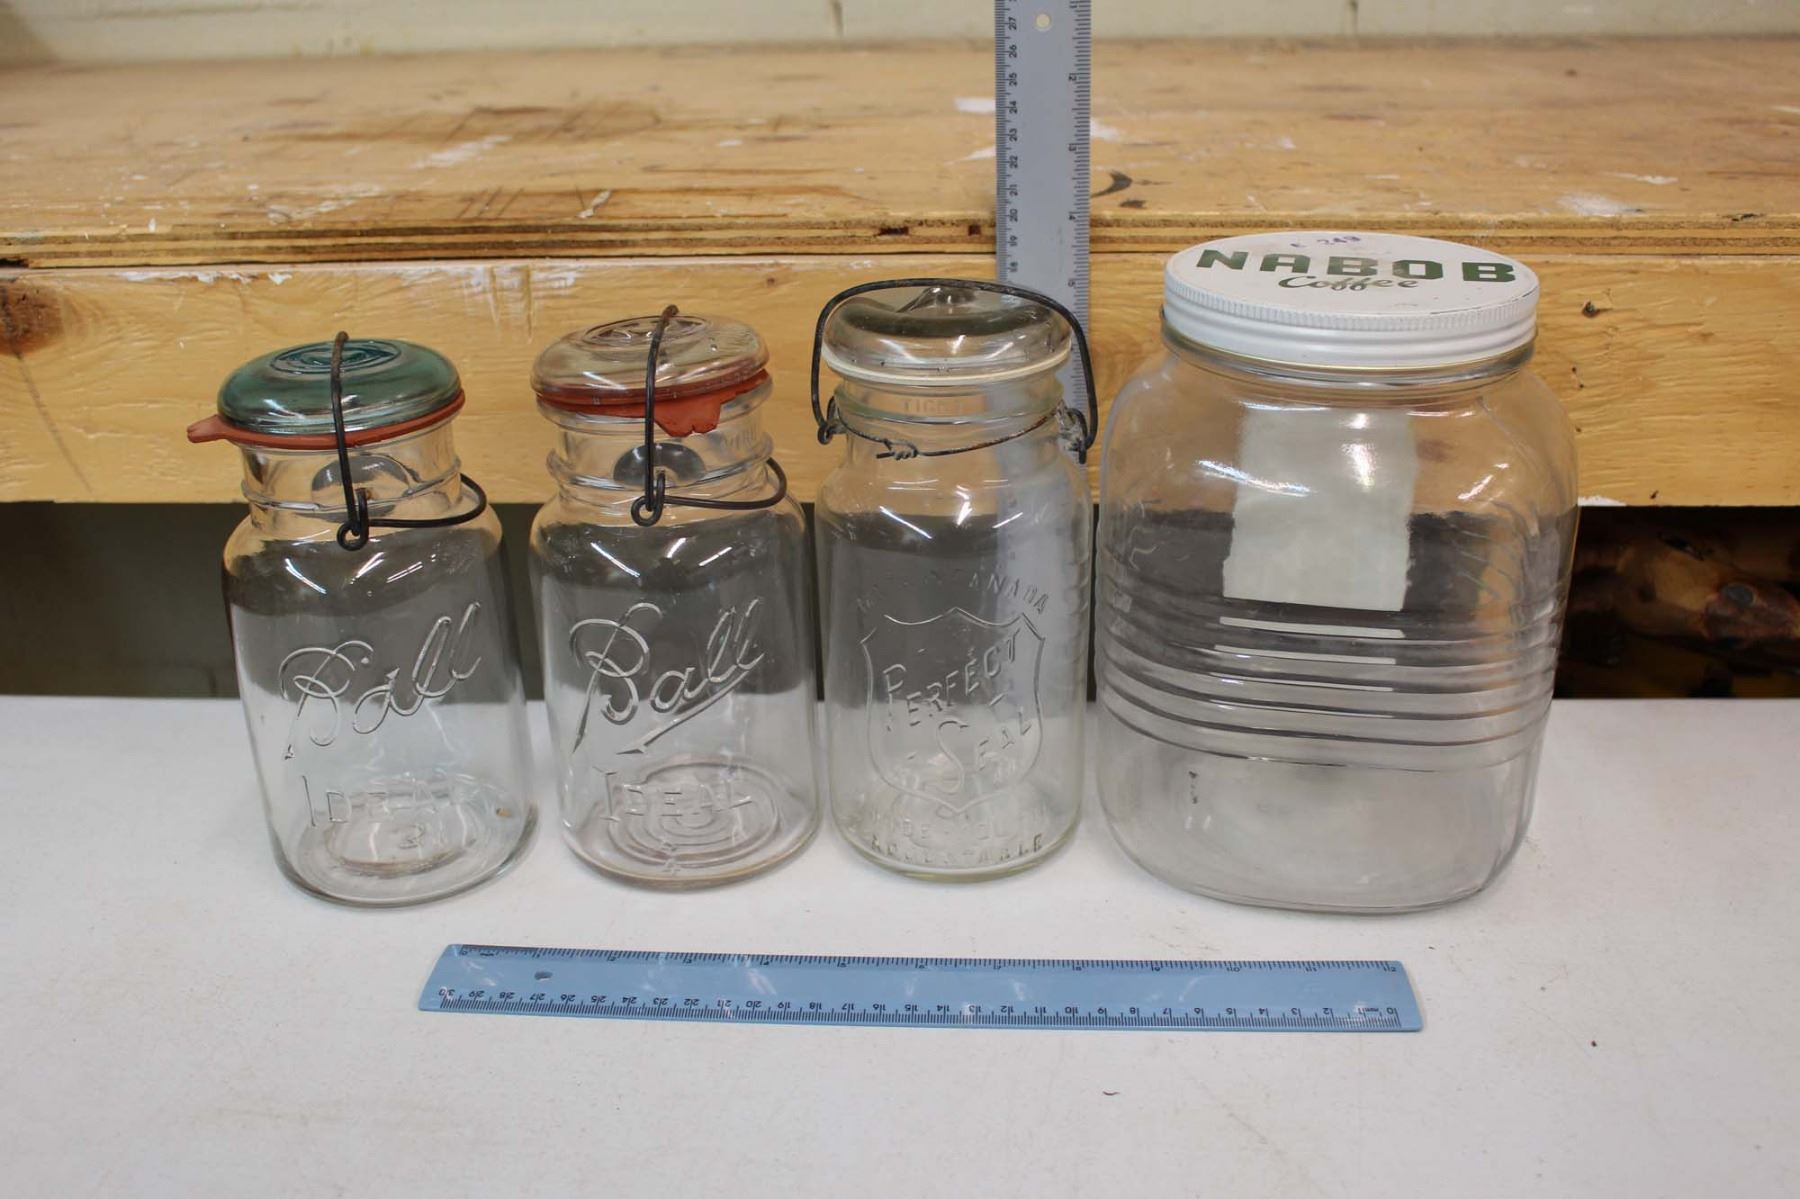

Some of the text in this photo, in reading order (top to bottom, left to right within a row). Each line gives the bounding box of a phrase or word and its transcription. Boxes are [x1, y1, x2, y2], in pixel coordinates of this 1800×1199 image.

[1008, 17, 1018, 30] 27
[1008, 44, 1018, 58] 26
[1008, 72, 1018, 87] 25
[1008, 101, 1018, 114] 24
[1008, 128, 1018, 142] 23
[1008, 156, 1018, 169] 22
[1008, 184, 1018, 196] 21
[1008, 208, 1018, 222] 20
[1008, 235, 1018, 247] 19
[1196, 250, 1516, 283] NABOB
[1278, 275, 1419, 292] Coffee
[279, 602, 482, 760] Ball
[570, 599, 765, 755] Ball
[438, 988, 456, 998] 30
[468, 990, 485, 998] 29
[499, 991, 515, 999] 28
[529, 992, 546, 1001] 27
[560, 994, 576, 1002] 26
[591, 995, 607, 1003] 25
[621, 996, 637, 1004] 24
[653, 997, 669, 1005] 23
[683, 998, 700, 1006] 22
[717, 999, 732, 1007] 21
[745, 1000, 762, 1008] 20
[777, 1001, 791, 1009] 19
[809, 1002, 823, 1010] 18
[873, 1003, 887, 1011] 16
[904, 1004, 918, 1012] 15
[936, 1004, 950, 1012] 14
[968, 1005, 982, 1013] 13
[1000, 1005, 1014, 1013] 12
[1034, 1006, 1047, 1014] 11
[1065, 1006, 1079, 1014] 10
